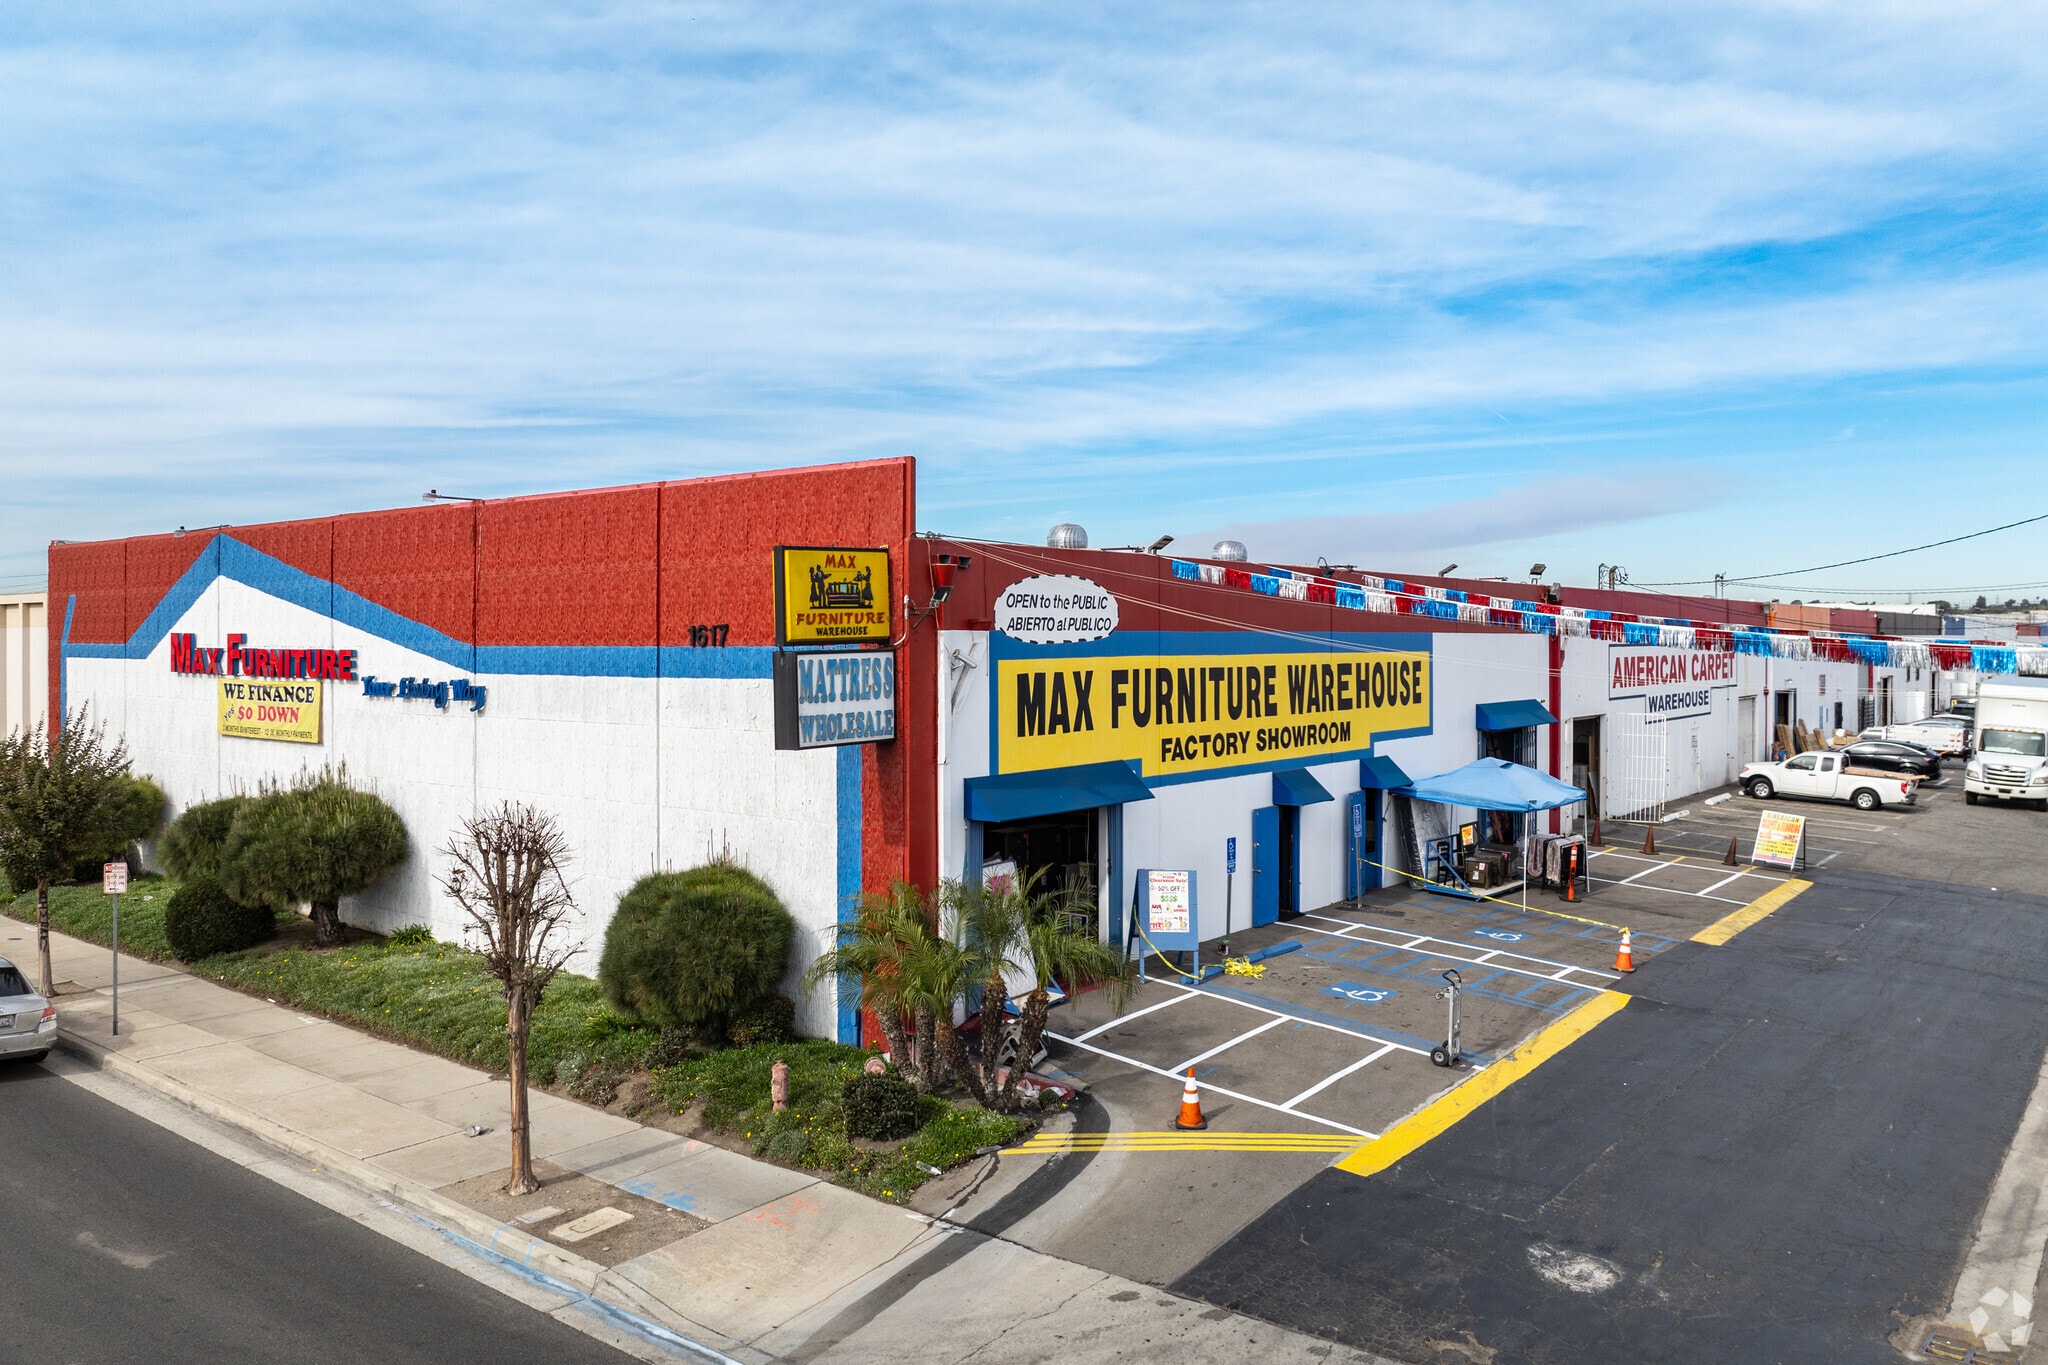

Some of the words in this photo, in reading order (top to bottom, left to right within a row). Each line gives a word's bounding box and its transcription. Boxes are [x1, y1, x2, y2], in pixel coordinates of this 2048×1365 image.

[825, 554, 856, 569] MAX
[1006, 593, 1039, 608] OPEN
[1040, 595, 1051, 608] to
[1054, 594, 1070, 610] the
[1072, 594, 1108, 610] PUBLIC
[796, 612, 885, 626] FURNITURE
[1006, 617, 1055, 631] ABIERTO
[1056, 617, 1067, 631] al
[1068, 618, 1112, 631] PUBLICO
[688, 624, 729, 648] 1617
[816, 626, 868, 636] WAREHOUSE
[170, 632, 224, 676] MAX
[226, 633, 358, 680] FURNITURE
[799, 657, 893, 704] MATTRESS
[1612, 654, 1686, 689] AMERICAN
[1691, 652, 1736, 682] CARPET
[224, 683, 245, 700] WE
[248, 684, 314, 703] FINANCE
[450, 678, 486, 712] Way
[1016, 670, 1094, 738] MAX
[1111, 664, 1278, 729] FURNITURE
[1287, 660, 1422, 716] WAREHOUSE
[1648, 690, 1709, 713] WAREHOUSE
[238, 705, 253, 721] $0
[258, 705, 300, 723] DOWN
[799, 710, 894, 743] WHOLESALE
[1161, 730, 1250, 762] FACTORY
[1256, 720, 1351, 752] SHOWROOM
